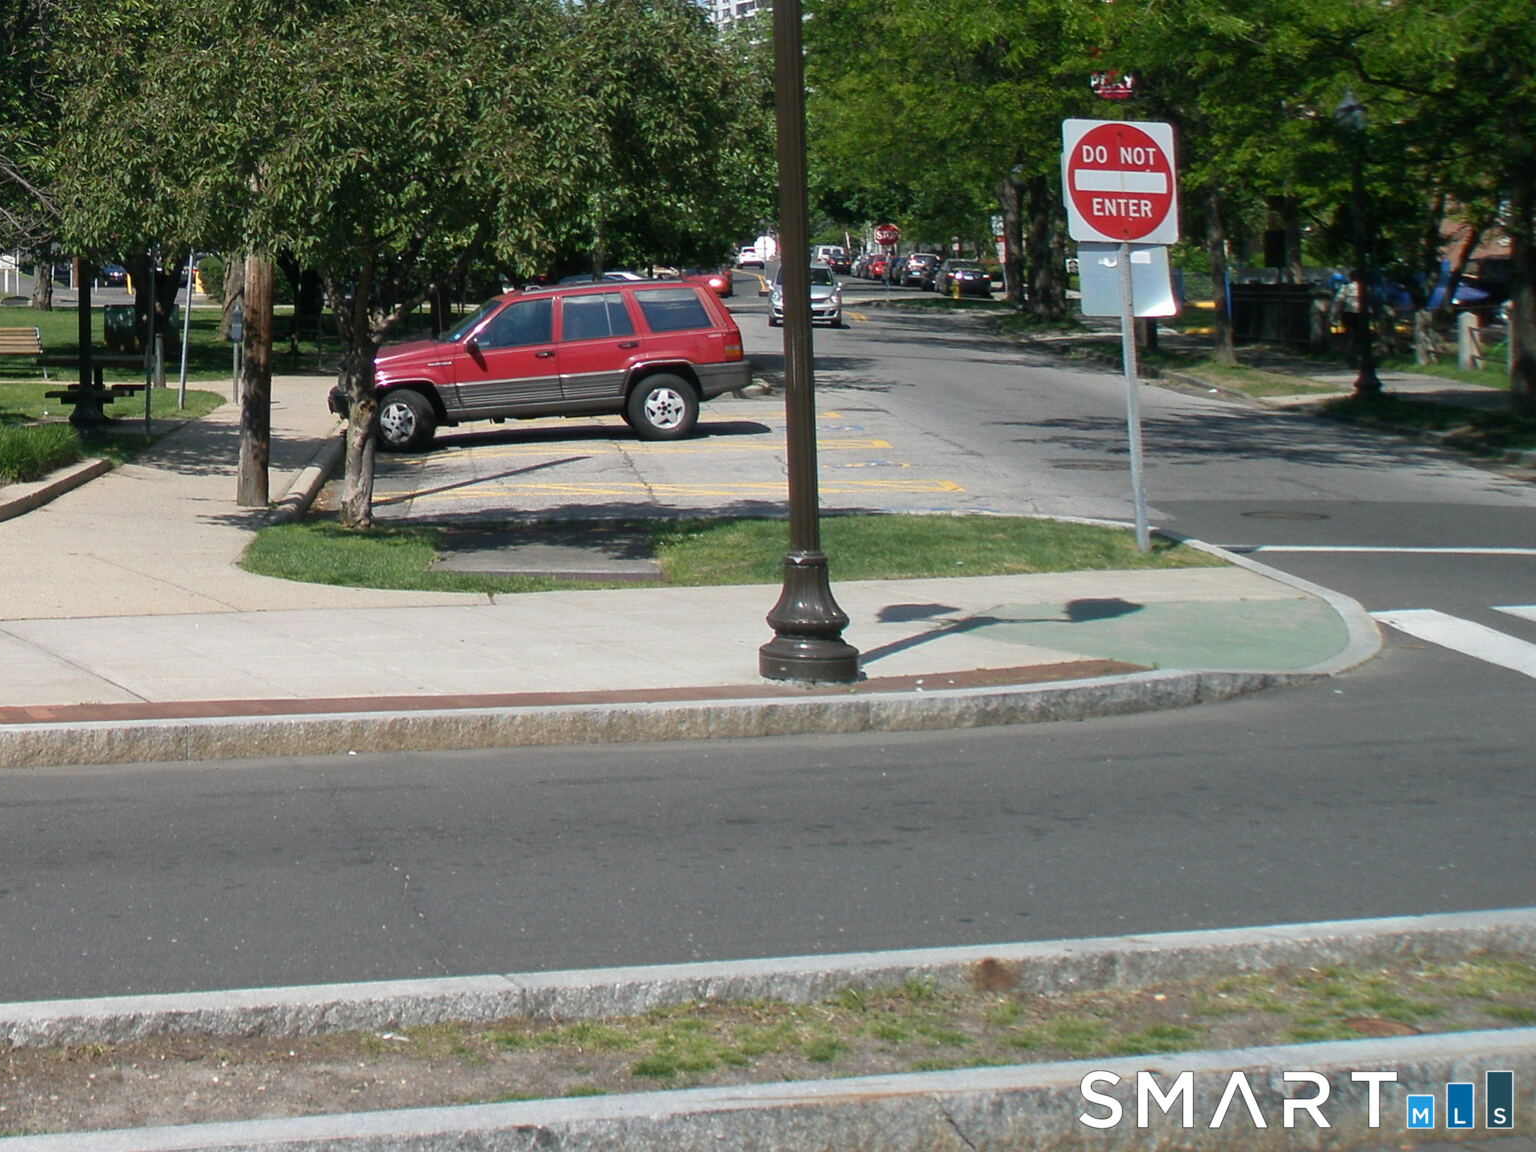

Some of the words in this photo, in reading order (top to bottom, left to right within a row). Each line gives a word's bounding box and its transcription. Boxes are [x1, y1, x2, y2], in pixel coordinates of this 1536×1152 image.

[1081, 145, 1108, 164] DO
[1120, 147, 1157, 166] NOT
[1092, 198, 1153, 218] ENTER
[876, 231, 899, 240] STOP
